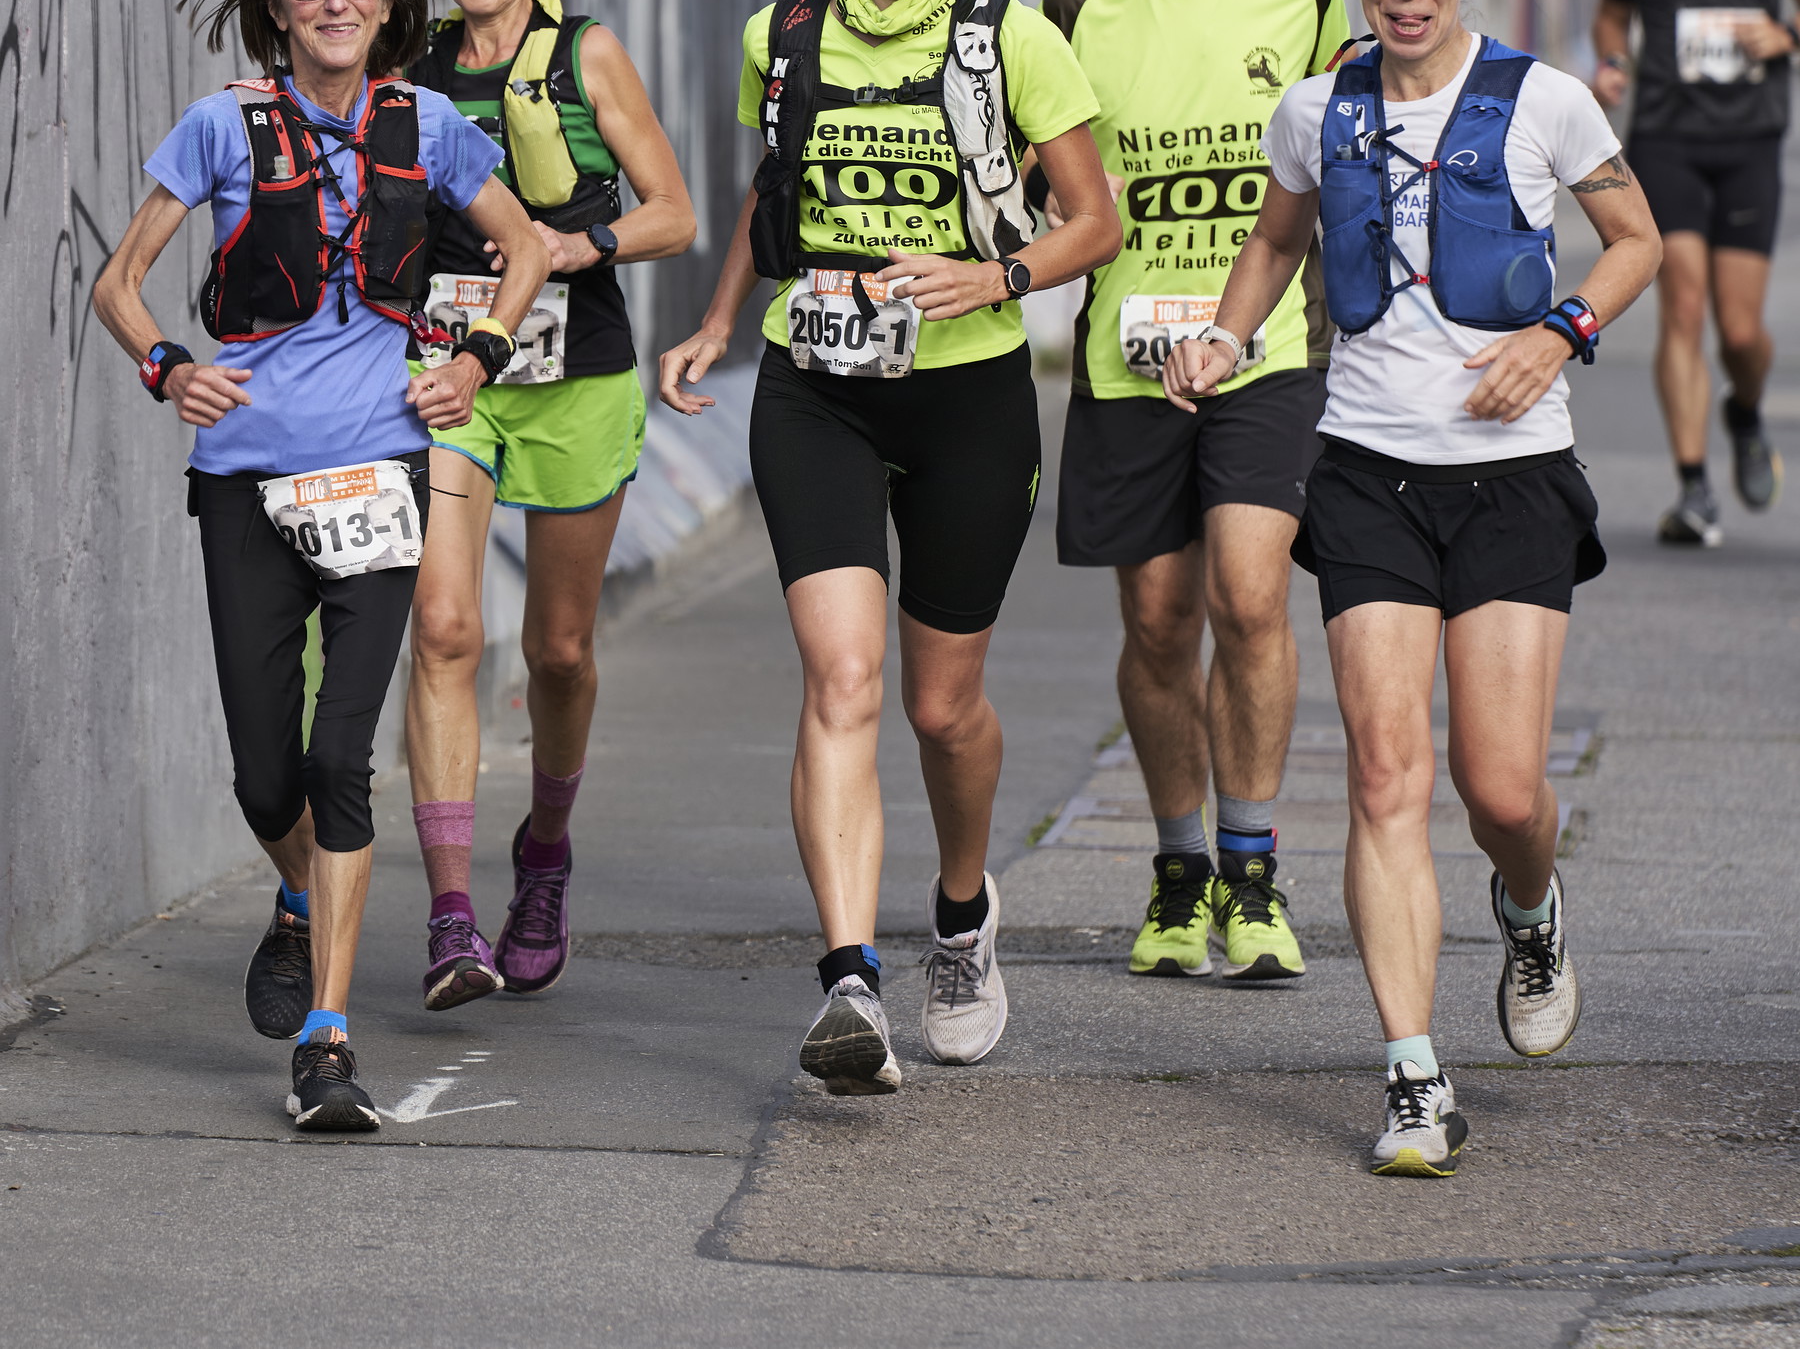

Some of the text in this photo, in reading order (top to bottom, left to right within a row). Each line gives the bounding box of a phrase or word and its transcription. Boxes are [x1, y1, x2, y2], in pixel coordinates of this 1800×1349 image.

[921, 106, 941, 114] MAUE
[808, 123, 949, 146] iemand
[1117, 121, 1263, 154] Nieman
[818, 144, 853, 157] die
[862, 144, 952, 162] Absicht
[1122, 146, 1266, 173] hat die Absic
[802, 164, 940, 203] 100
[1136, 172, 1269, 217] 100
[809, 206, 951, 231] Meilen
[1394, 211, 1429, 227] BAR
[832, 232, 934, 248] zu laufen!
[1125, 223, 1249, 252] Meile
[1144, 256, 1166, 272] zu
[817, 270, 838, 292] 100
[841, 286, 884, 297] BLIN
[457, 282, 481, 304] 100
[1156, 302, 1183, 321] 100
[790, 307, 908, 355] 2050-1
[814, 356, 872, 371] Team TomSon
[331, 471, 373, 482] MEILEN
[297, 478, 326, 503] 100
[332, 486, 375, 497] BERLIN
[278, 505, 413, 557] 2013-1
